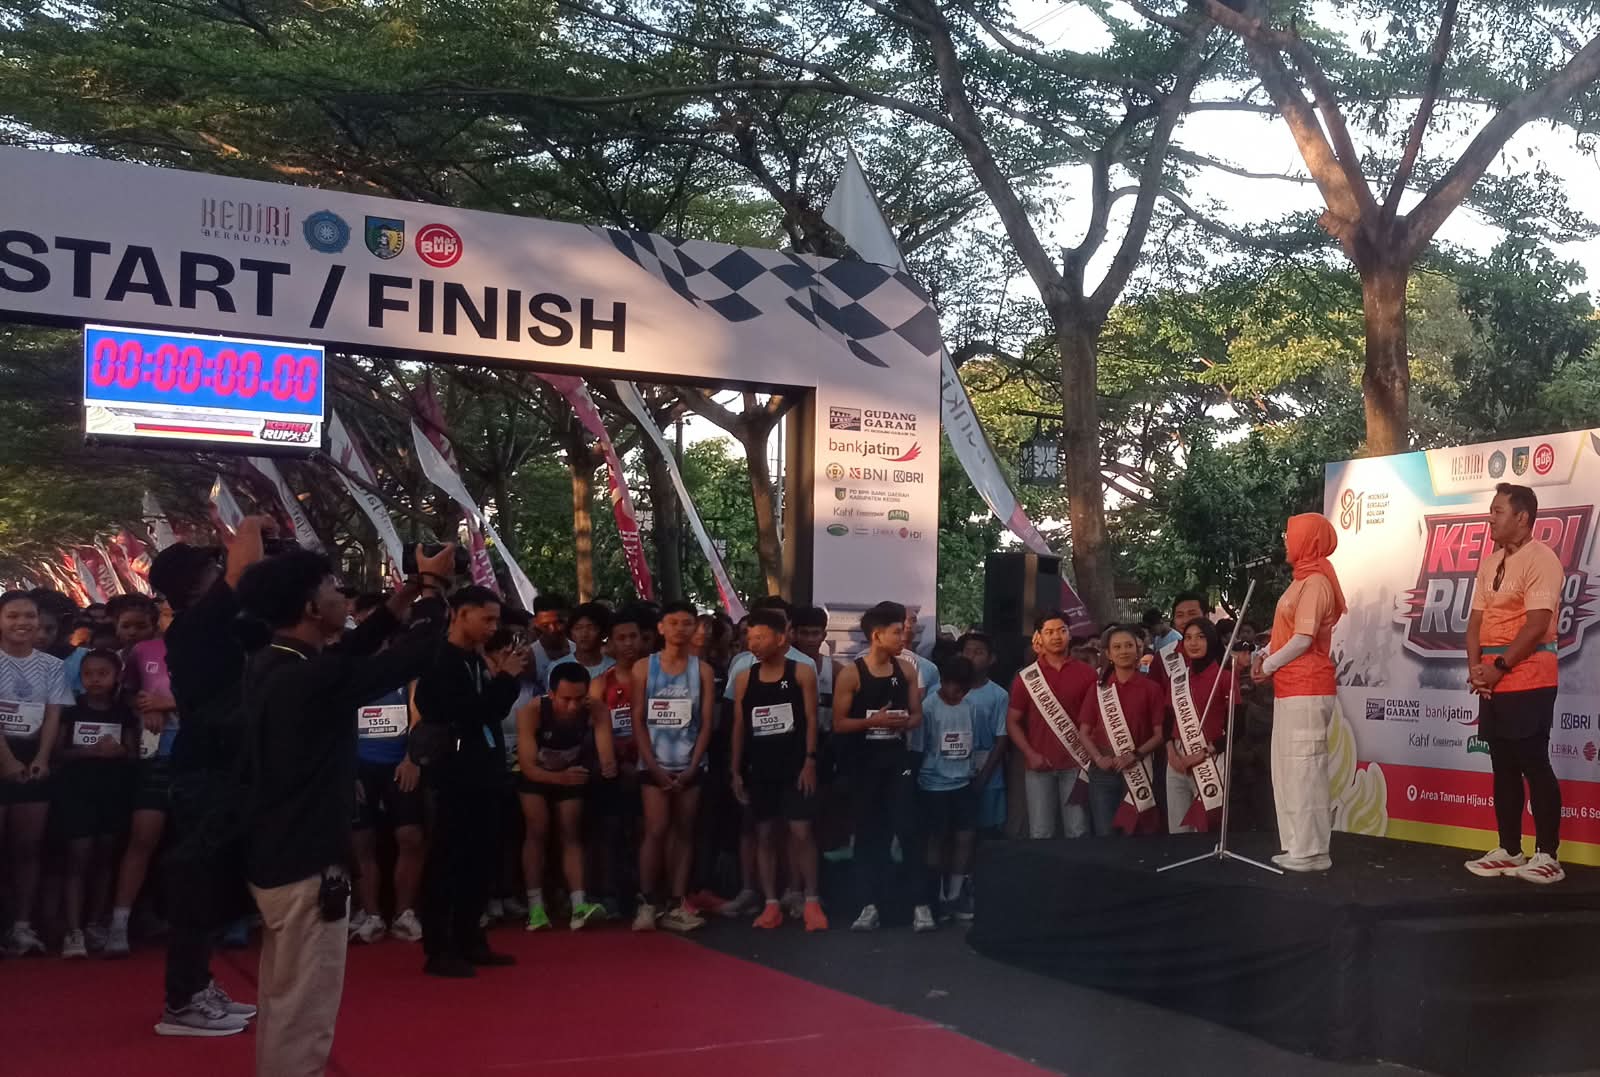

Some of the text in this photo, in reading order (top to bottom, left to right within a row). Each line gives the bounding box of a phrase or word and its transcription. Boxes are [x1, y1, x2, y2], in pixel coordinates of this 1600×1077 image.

[0, 230, 627, 353] START / FINISH
[864, 410, 917, 422] GUDANG
[864, 419, 917, 431] GARAM
[828, 438, 900, 457] bankjatim
[863, 468, 924, 484] BNI BRI
[1428, 515, 1582, 573] KERI
[1420, 578, 1478, 633] RU
[1175, 695, 1193, 725] KIRANA
[1386, 699, 1420, 709] GUDANG
[1386, 707, 1420, 718] GARAM
[1103, 702, 1121, 730] KIRANA
[1425, 704, 1473, 722] bankjatim
[1572, 714, 1591, 729] BRI
[82, 735, 98, 744] 09
[1409, 733, 1430, 747] Kahf
[1128, 768, 1145, 787] 2024
[1197, 764, 1214, 783] 2024
[1420, 789, 1439, 800] Area
[1440, 791, 1465, 804] Taman
[1466, 795, 1487, 807] Hijau
[1580, 807, 1588, 818] 6
